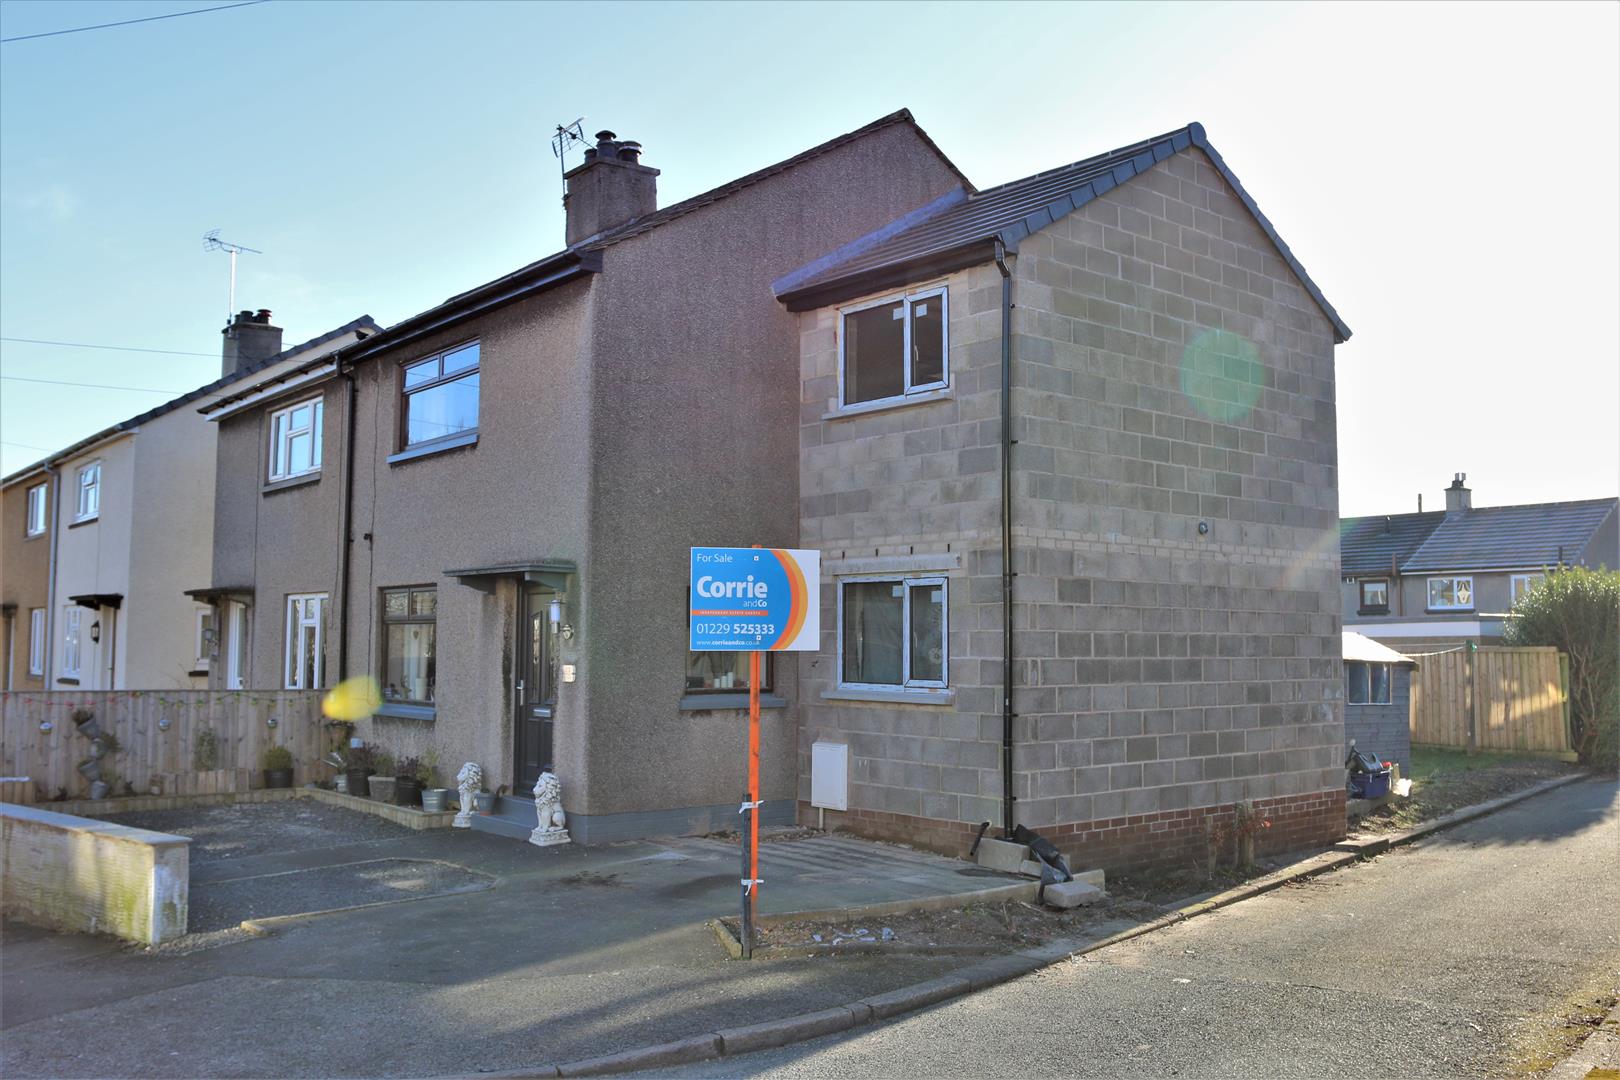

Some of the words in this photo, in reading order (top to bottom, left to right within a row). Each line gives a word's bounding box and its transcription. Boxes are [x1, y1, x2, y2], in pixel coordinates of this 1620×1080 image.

[696, 554, 712, 563] For
[714, 553, 733, 563] Sale
[696, 575, 768, 598] Corrie
[696, 623, 731, 635] 01229
[733, 623, 775, 635] 525333
